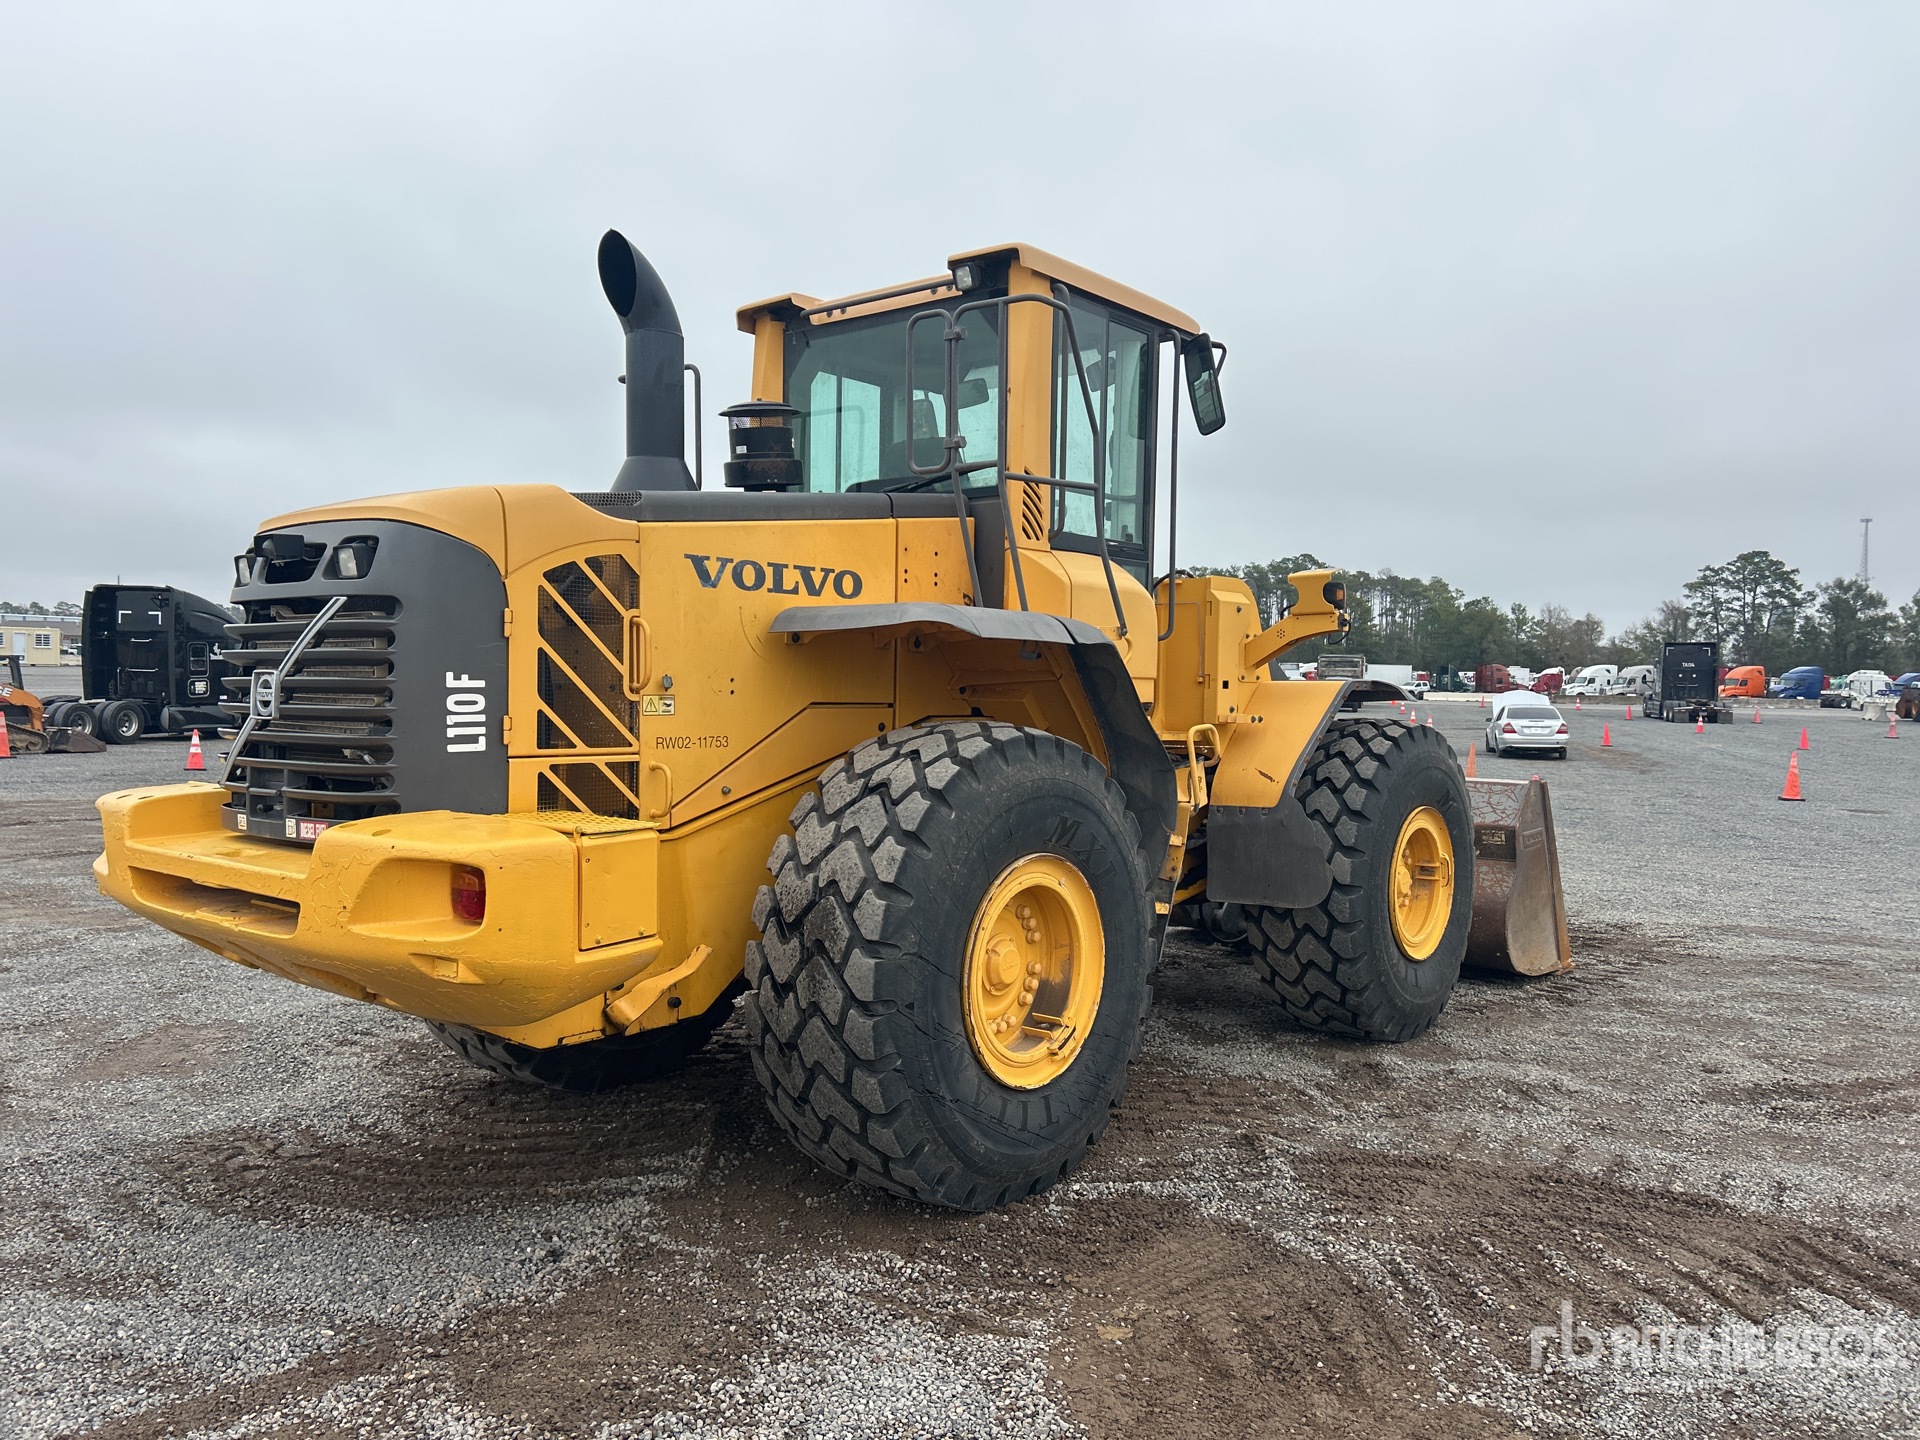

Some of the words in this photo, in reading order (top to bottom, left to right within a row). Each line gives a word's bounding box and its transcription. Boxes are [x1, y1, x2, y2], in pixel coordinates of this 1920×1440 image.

[684, 553, 863, 600] VOLVO
[446, 672, 486, 753] L110F
[655, 735, 729, 750] RW02-11753
